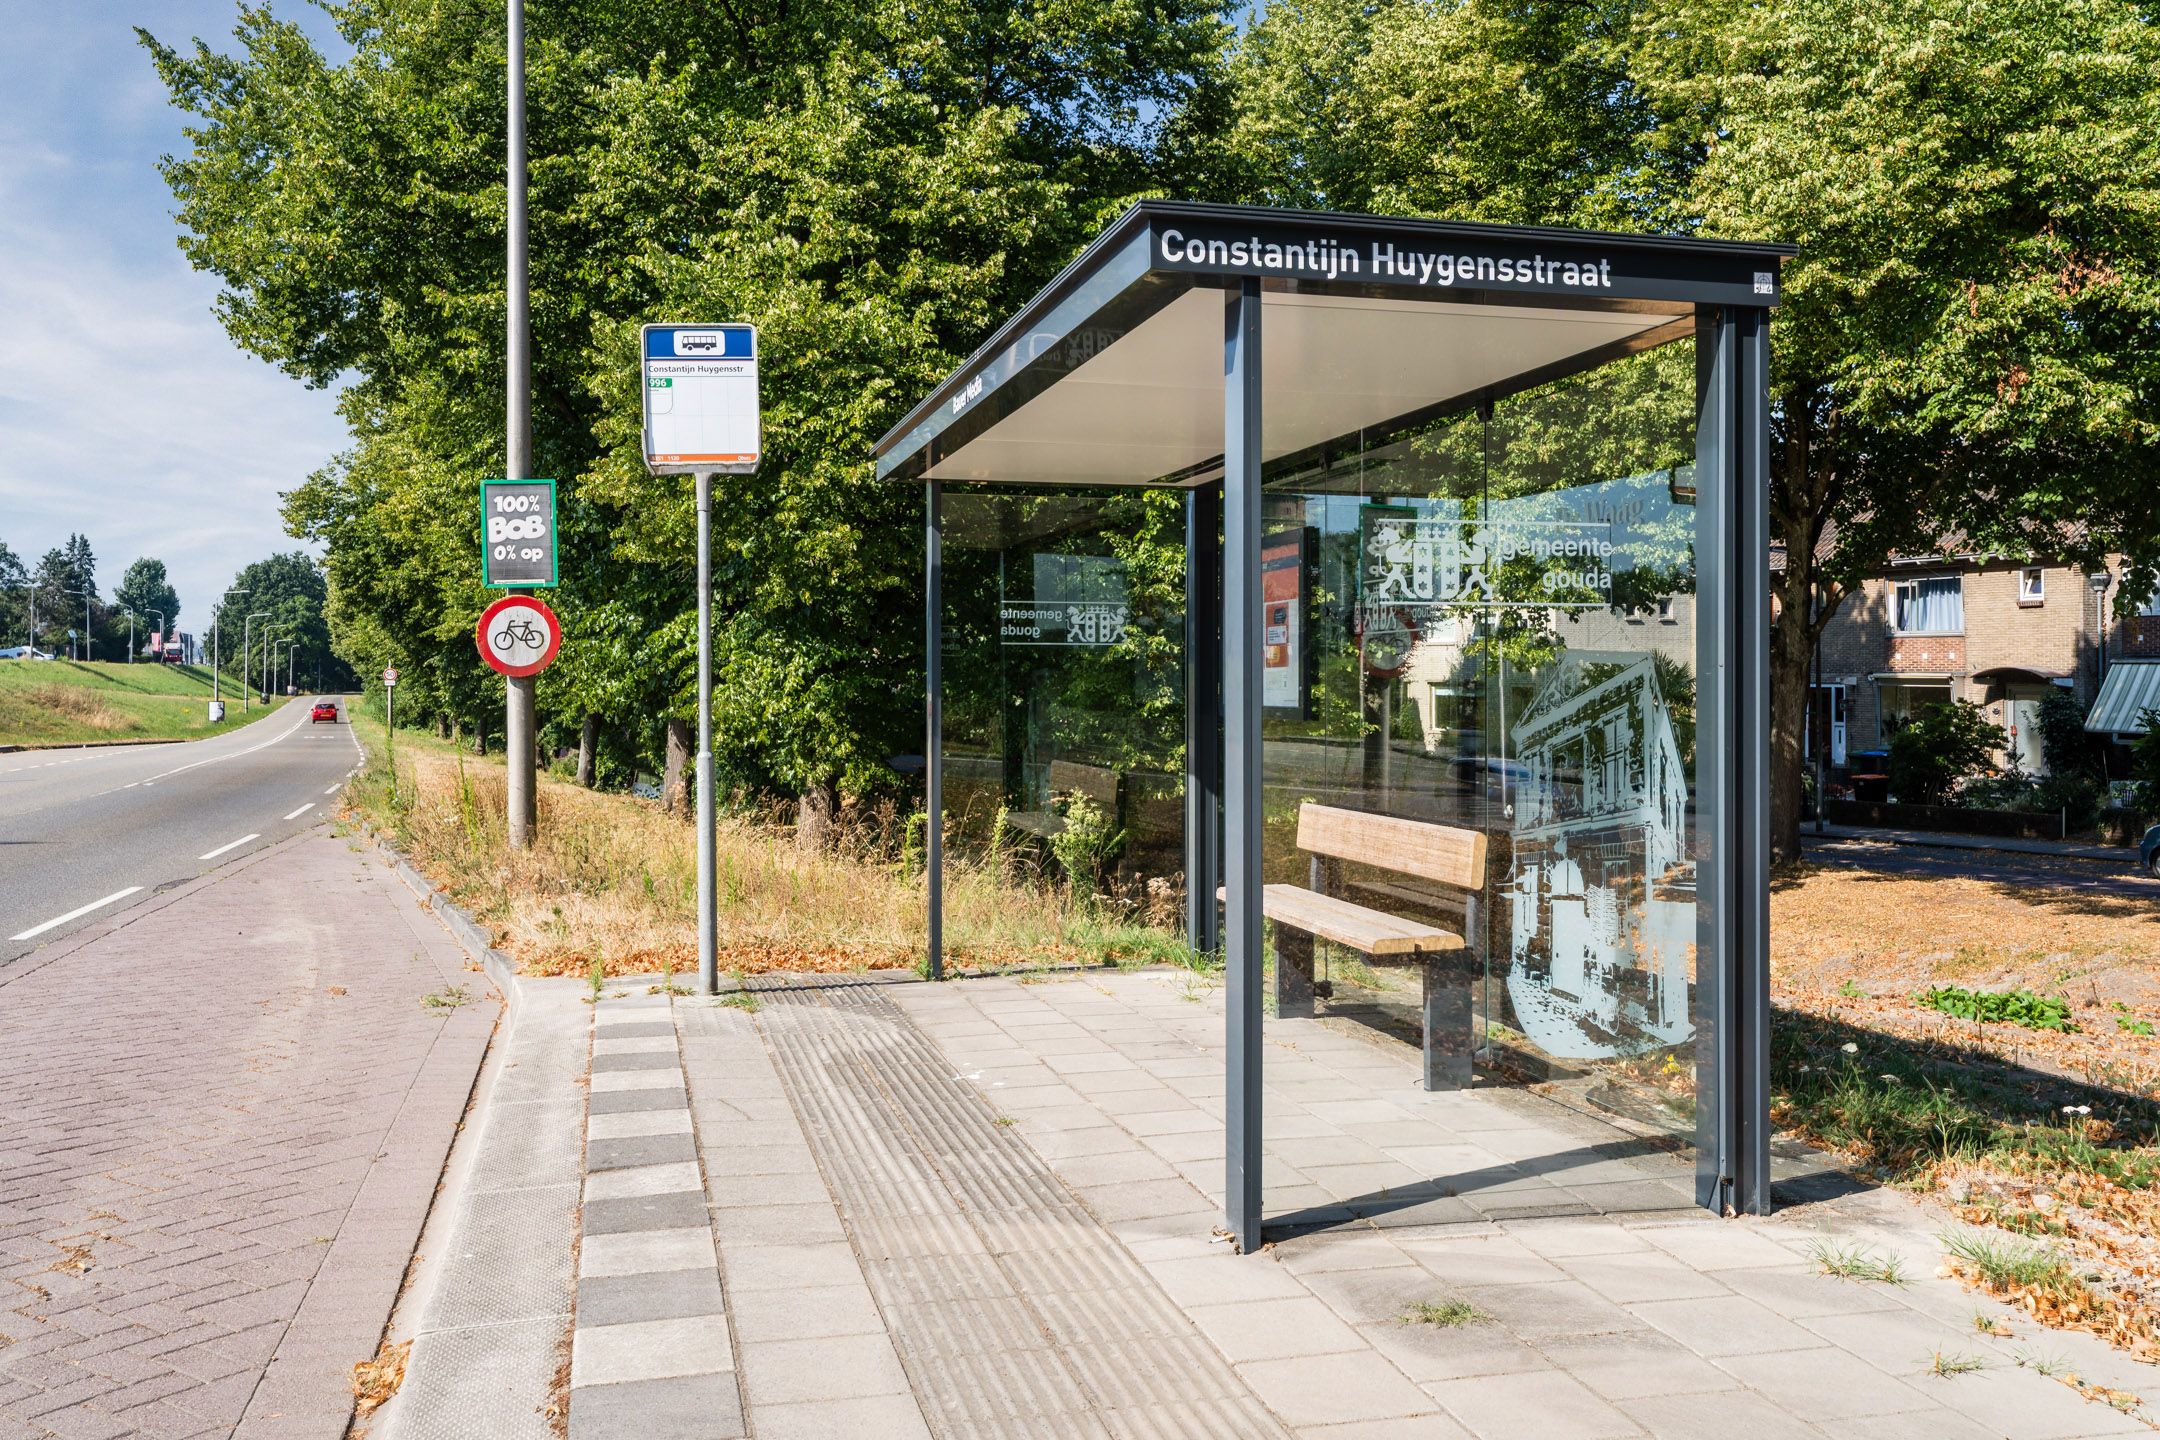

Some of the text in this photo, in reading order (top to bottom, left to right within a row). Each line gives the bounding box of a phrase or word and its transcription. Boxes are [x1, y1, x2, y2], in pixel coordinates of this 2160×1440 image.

[1161, 229, 1611, 287] Constantijn Huygensstraat
[648, 365, 744, 374] Constantijn Huygensstr
[649, 378, 667, 387] 996
[494, 495, 540, 513] 100%
[494, 544, 544, 562] 0% op
[1502, 537, 1612, 561] gemeente
[1542, 566, 1612, 594] gouda
